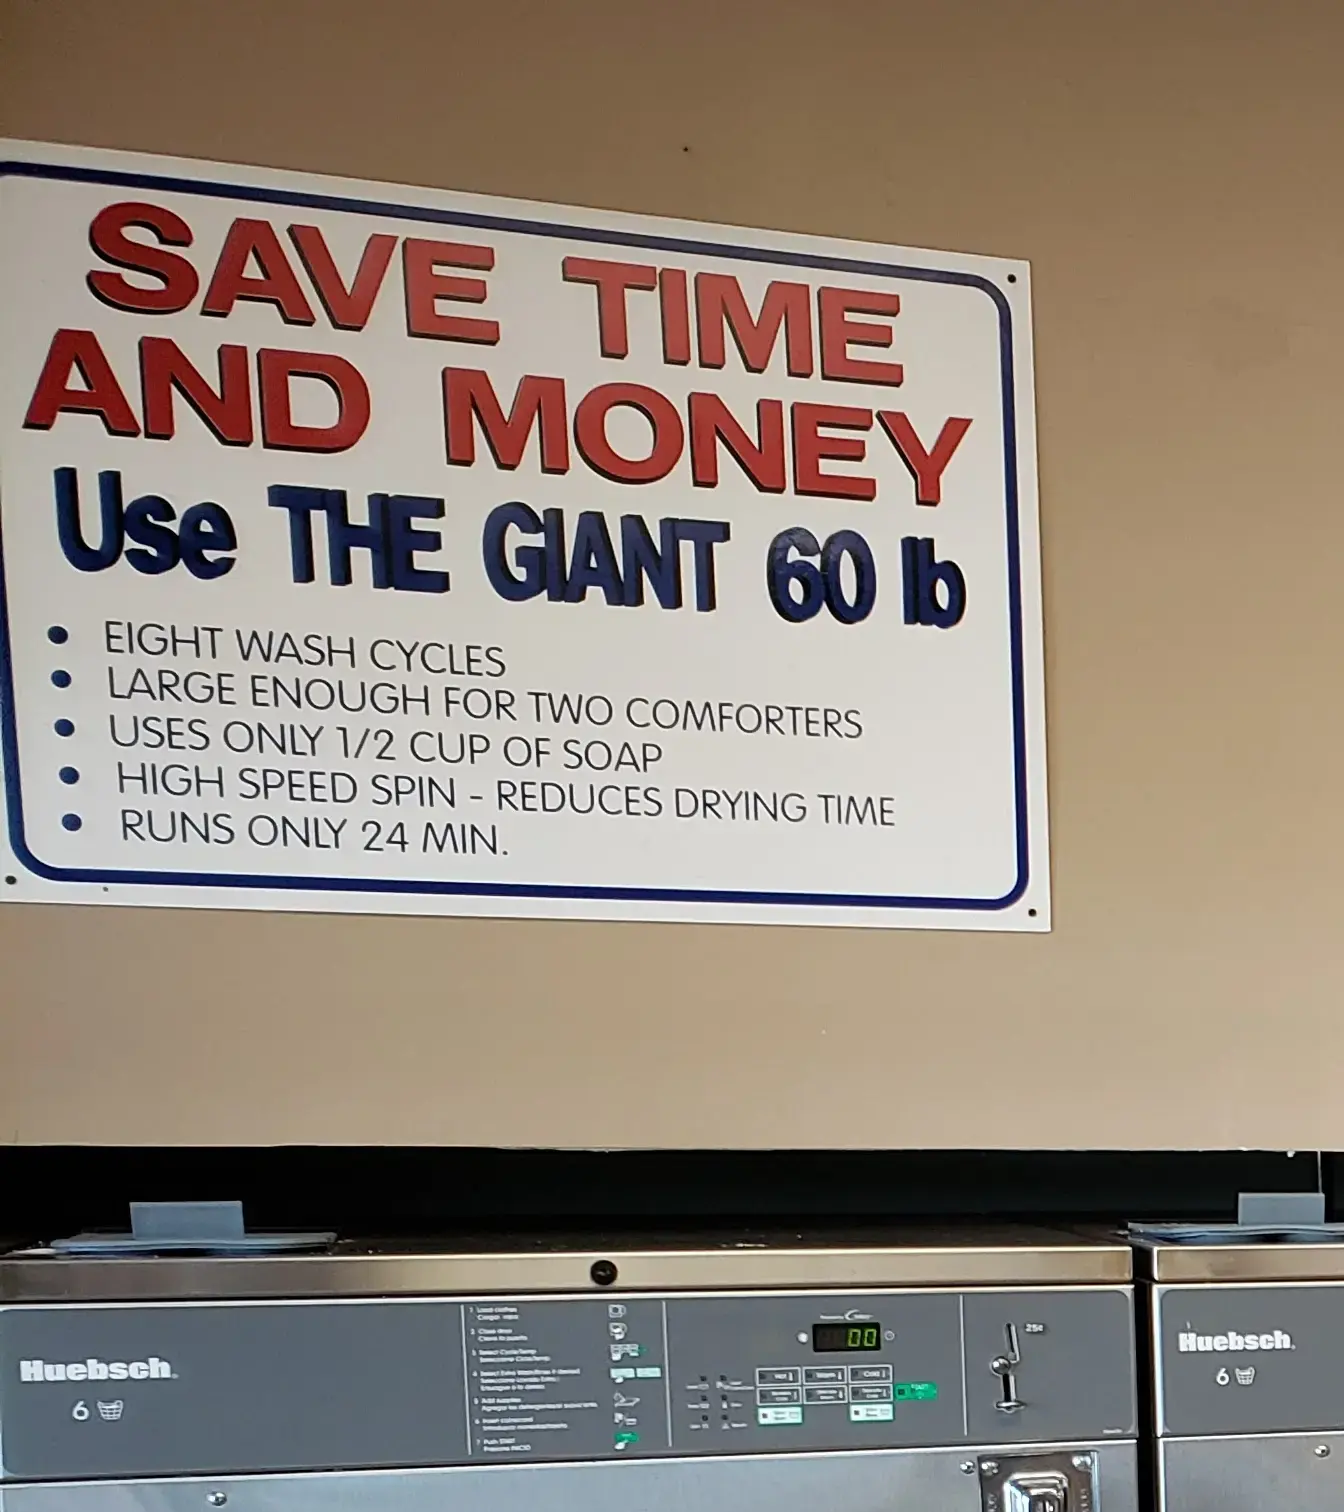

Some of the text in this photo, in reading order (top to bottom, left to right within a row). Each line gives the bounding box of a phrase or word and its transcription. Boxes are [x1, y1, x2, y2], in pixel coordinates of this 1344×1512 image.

[84, 201, 904, 389] SAVE TIME
[21, 327, 974, 508] AND MONEY
[53, 466, 967, 630] Use THE GIANT 60 lb
[105, 620, 506, 678] EIGHT WASH CYCLES
[108, 666, 863, 739] LARGE ENOUGH FOR TWO COMFORTERS
[109, 714, 663, 773] USES ONLY 1/2 CUP OF SOAP
[117, 761, 224, 798] HIGH
[238, 767, 358, 804] SPEED
[371, 774, 455, 809] SPIN
[497, 780, 663, 817] REDUCES
[675, 788, 807, 823] DRYING
[817, 794, 895, 826] TIME
[121, 809, 508, 856] RUNS ONLY 24 MIN.
[848, 1328, 876, 1347] 00
[1179, 1329, 1292, 1353] Huebsch
[20, 1357, 173, 1383] Huebsch
[1215, 1367, 1230, 1386] 6
[72, 1400, 89, 1421] 6
